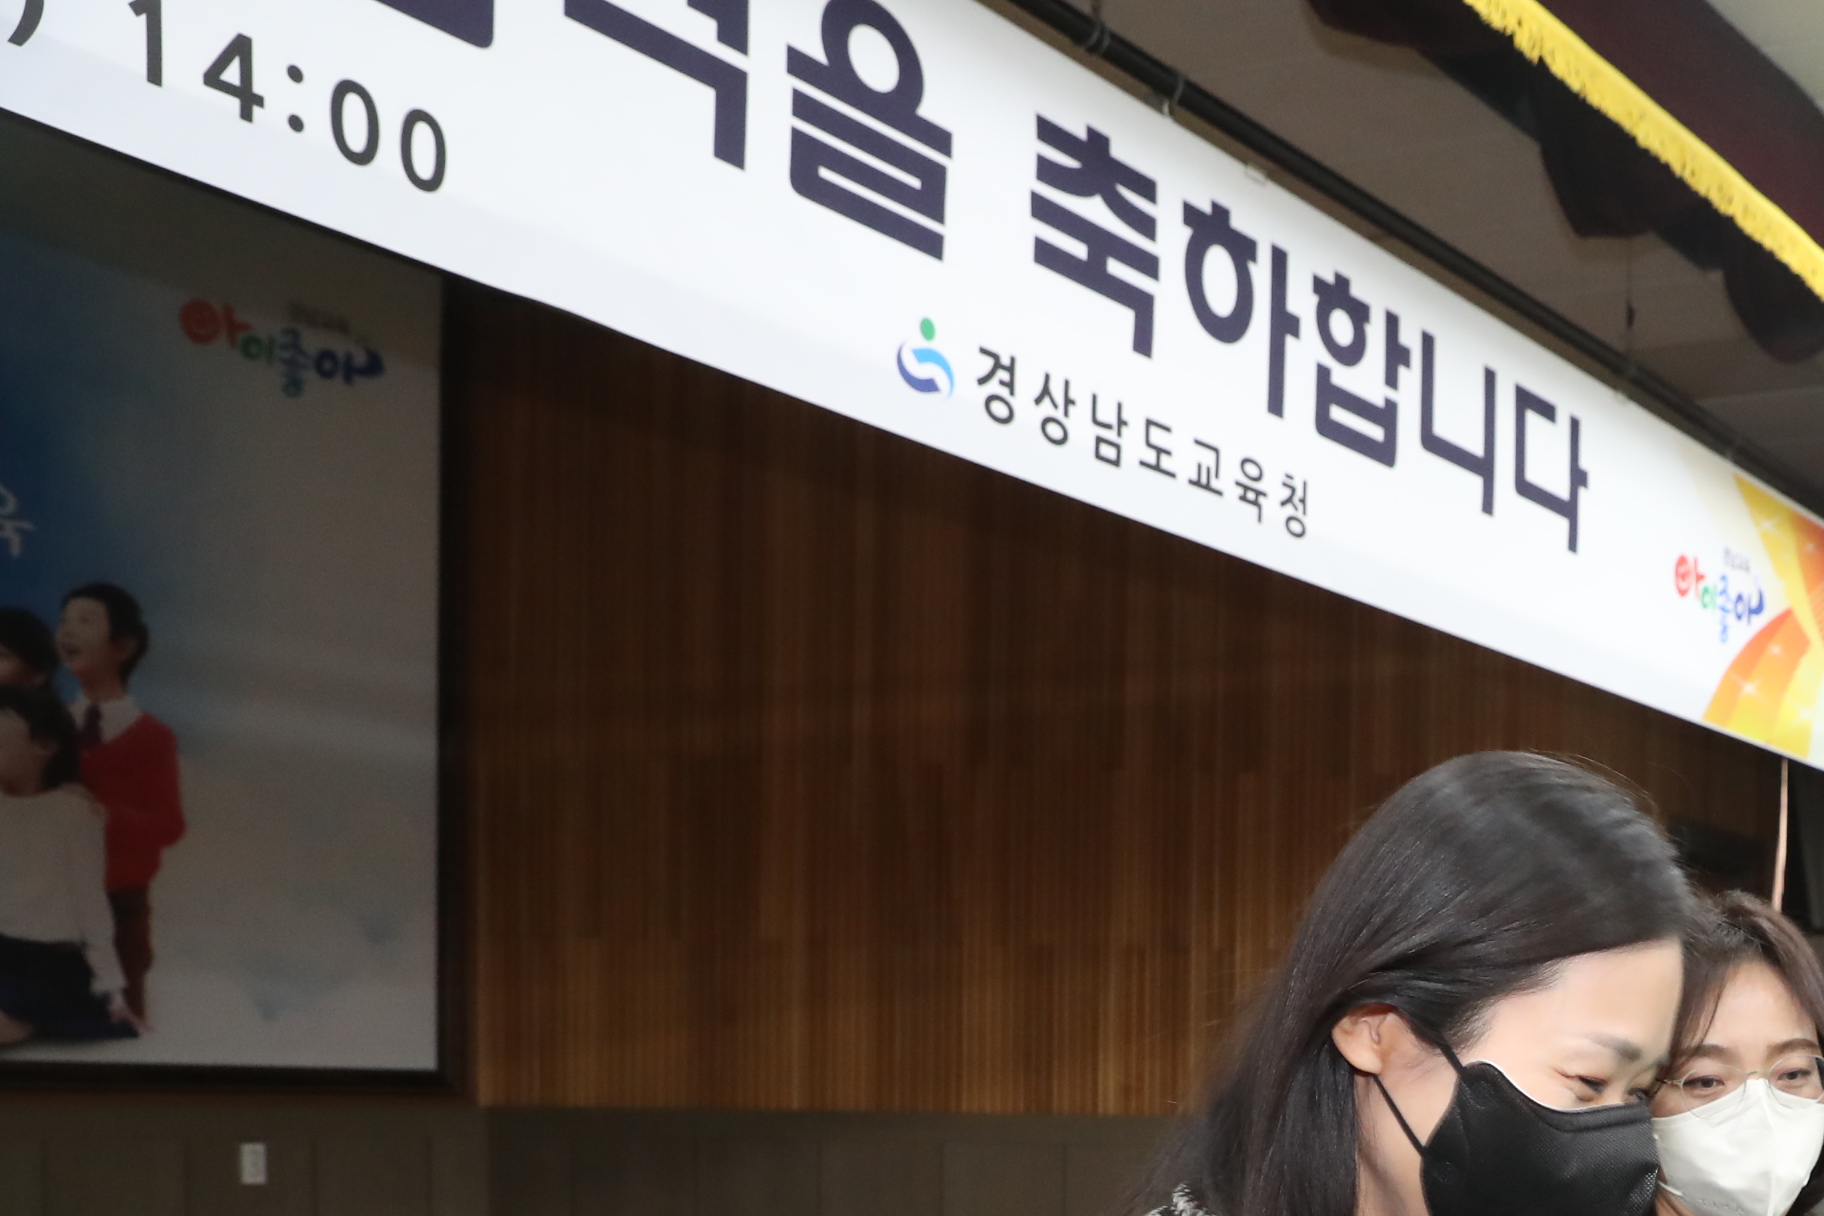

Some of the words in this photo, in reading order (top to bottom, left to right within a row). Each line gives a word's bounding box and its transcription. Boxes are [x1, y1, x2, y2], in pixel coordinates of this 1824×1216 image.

[128, 0, 446, 192] 14:00
[1030, 112, 1589, 554] 축하합니다
[975, 345, 1309, 541] 경상남도교육청
[1674, 553, 1765, 644] 아이좋아
